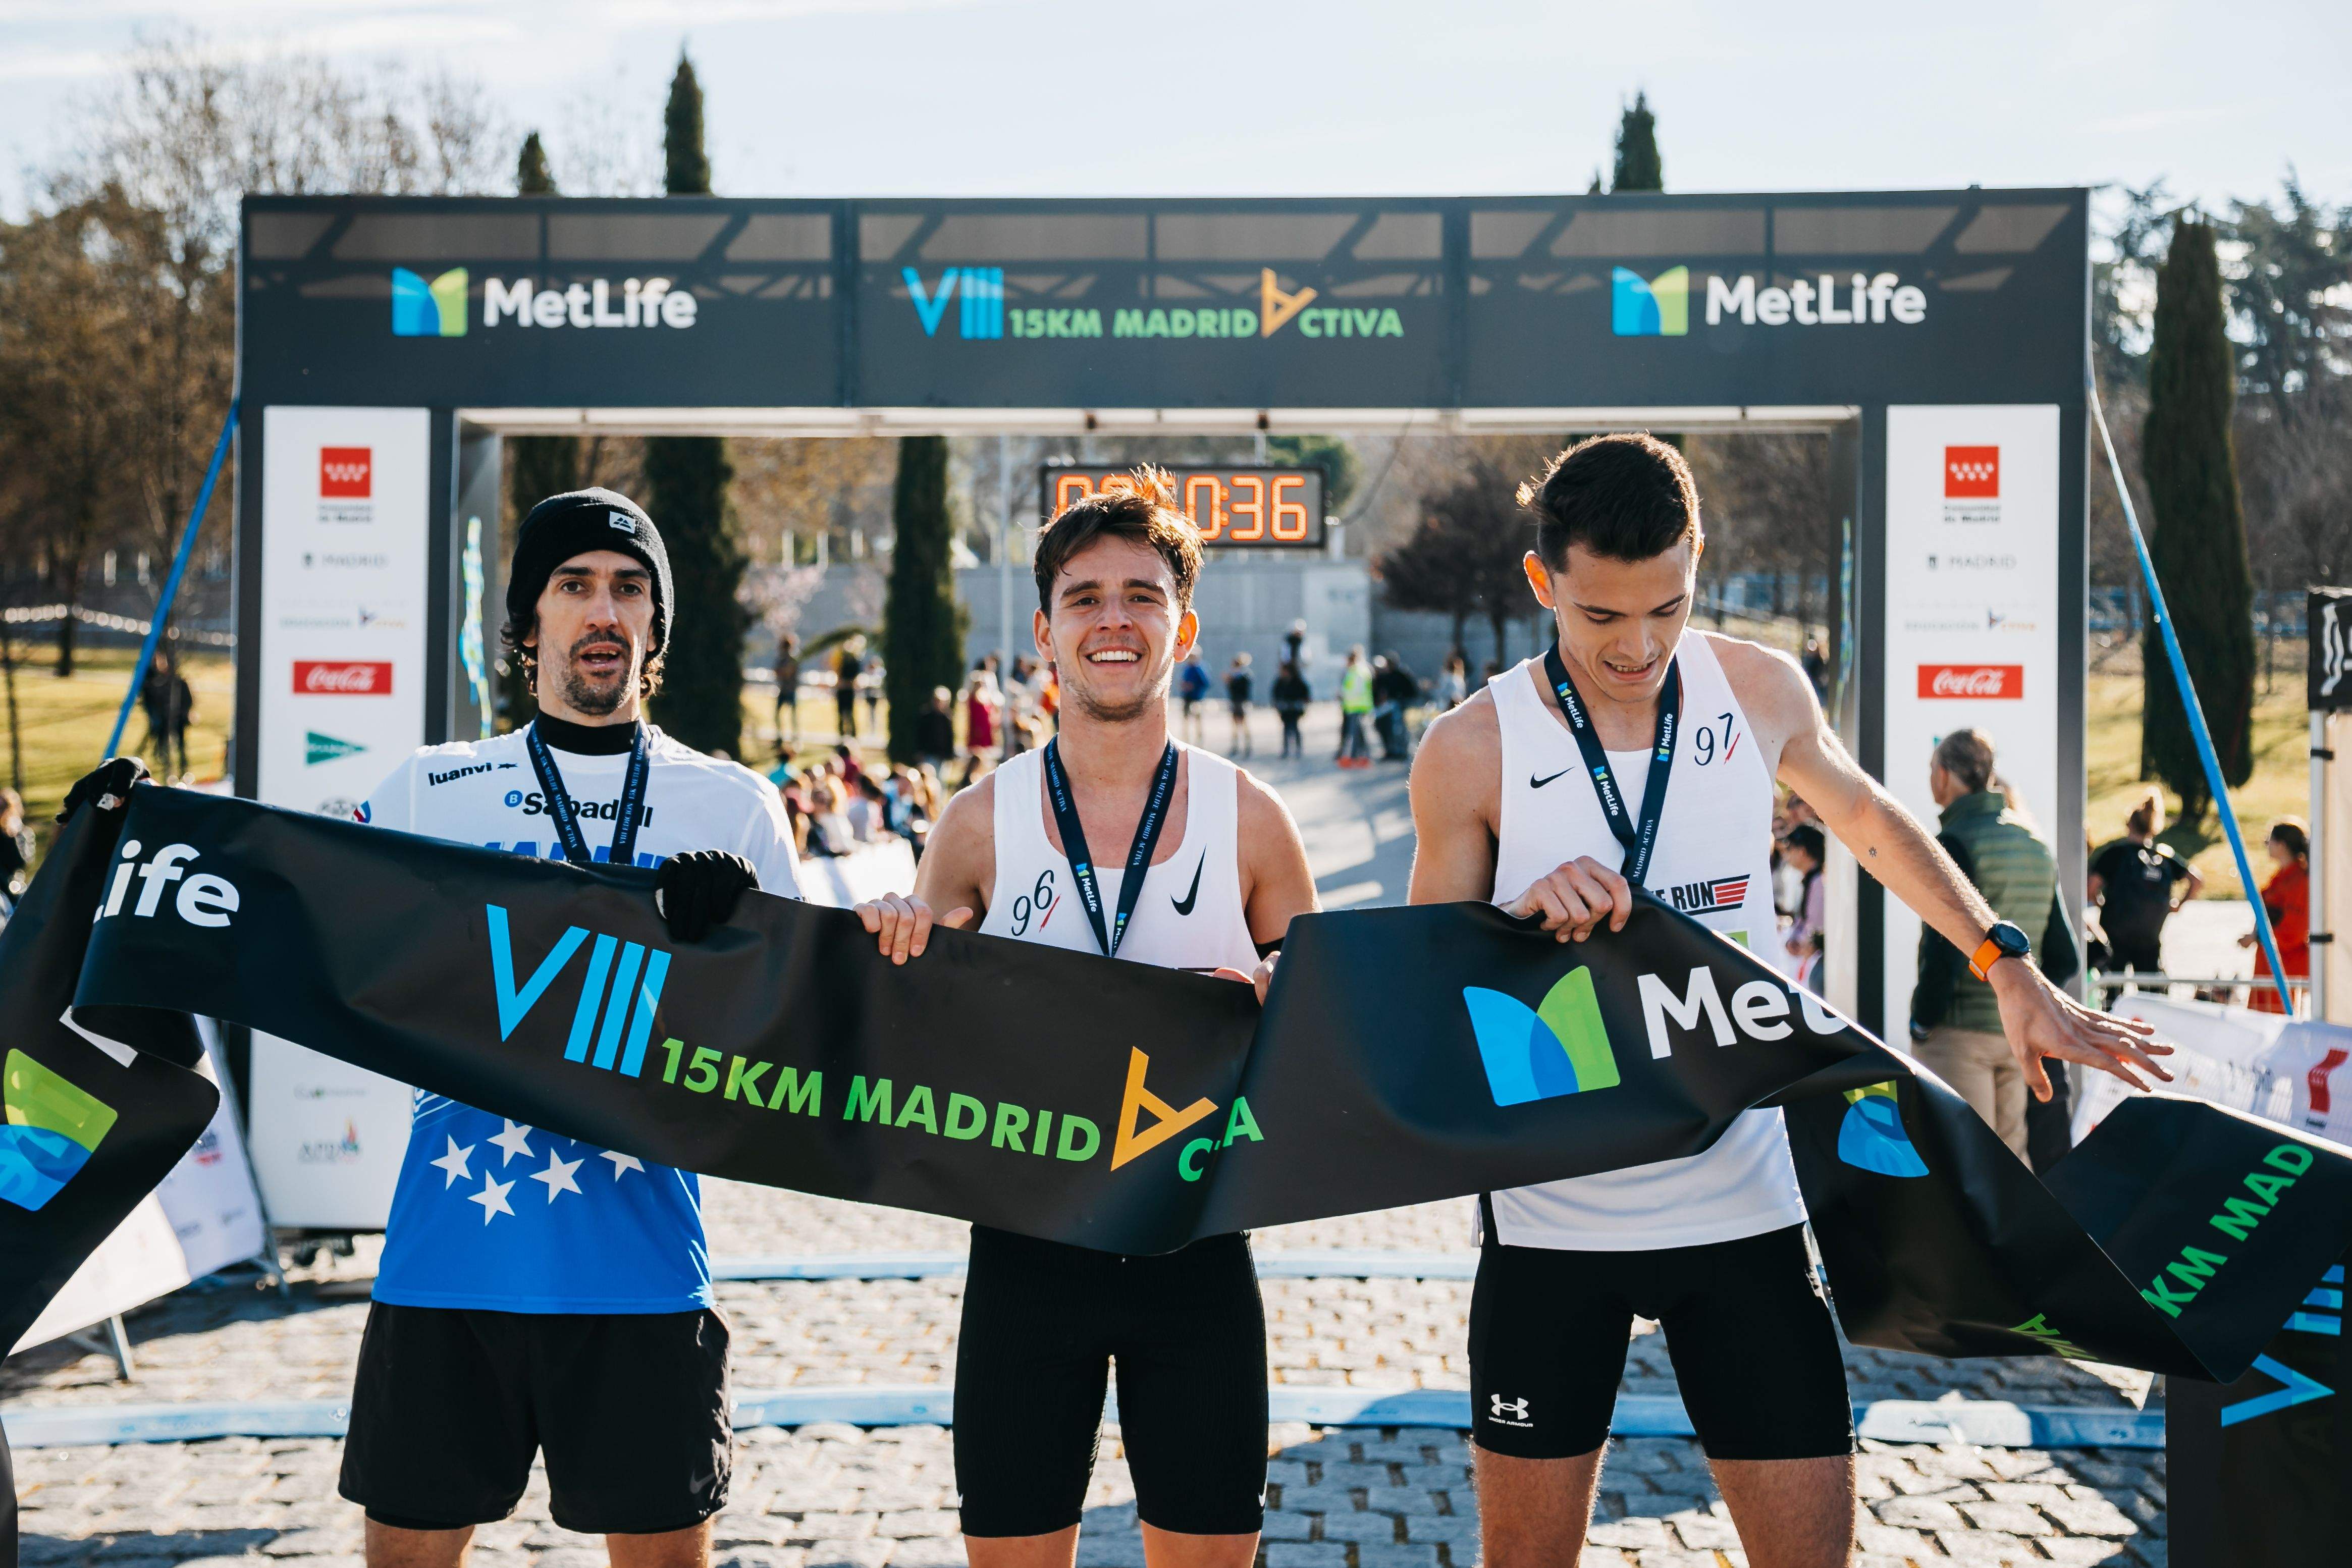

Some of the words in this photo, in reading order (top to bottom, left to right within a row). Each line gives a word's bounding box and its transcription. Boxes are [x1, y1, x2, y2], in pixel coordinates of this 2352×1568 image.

[484, 277, 697, 329] MetLife
[901, 266, 1003, 340] VIII
[1009, 308, 1103, 339] 15KM
[1112, 308, 1258, 339] MADRID
[1705, 273, 1927, 326] MetLife
[1565, 696, 1584, 729] MetLife
[1661, 713, 1673, 747] MetLife
[428, 762, 493, 786] luanvi
[522, 792, 654, 828] Sbadll
[555, 794, 569, 822] MADRID
[1056, 789, 1067, 812] ACTIVA
[1600, 780, 1618, 816] MetLife
[1143, 812, 1157, 839] MADRID
[1133, 841, 1146, 866] ACTIVA
[1633, 848, 1646, 878] MADRID
[1643, 820, 1653, 846] ACTIVA
[93, 840, 240, 927] ife
[1082, 878, 1097, 912] MetLife
[1671, 882, 1715, 910] RUN
[487, 904, 671, 1077] VIII
[662, 1038, 823, 1117] 15KM
[843, 1075, 1101, 1162] MADRID
